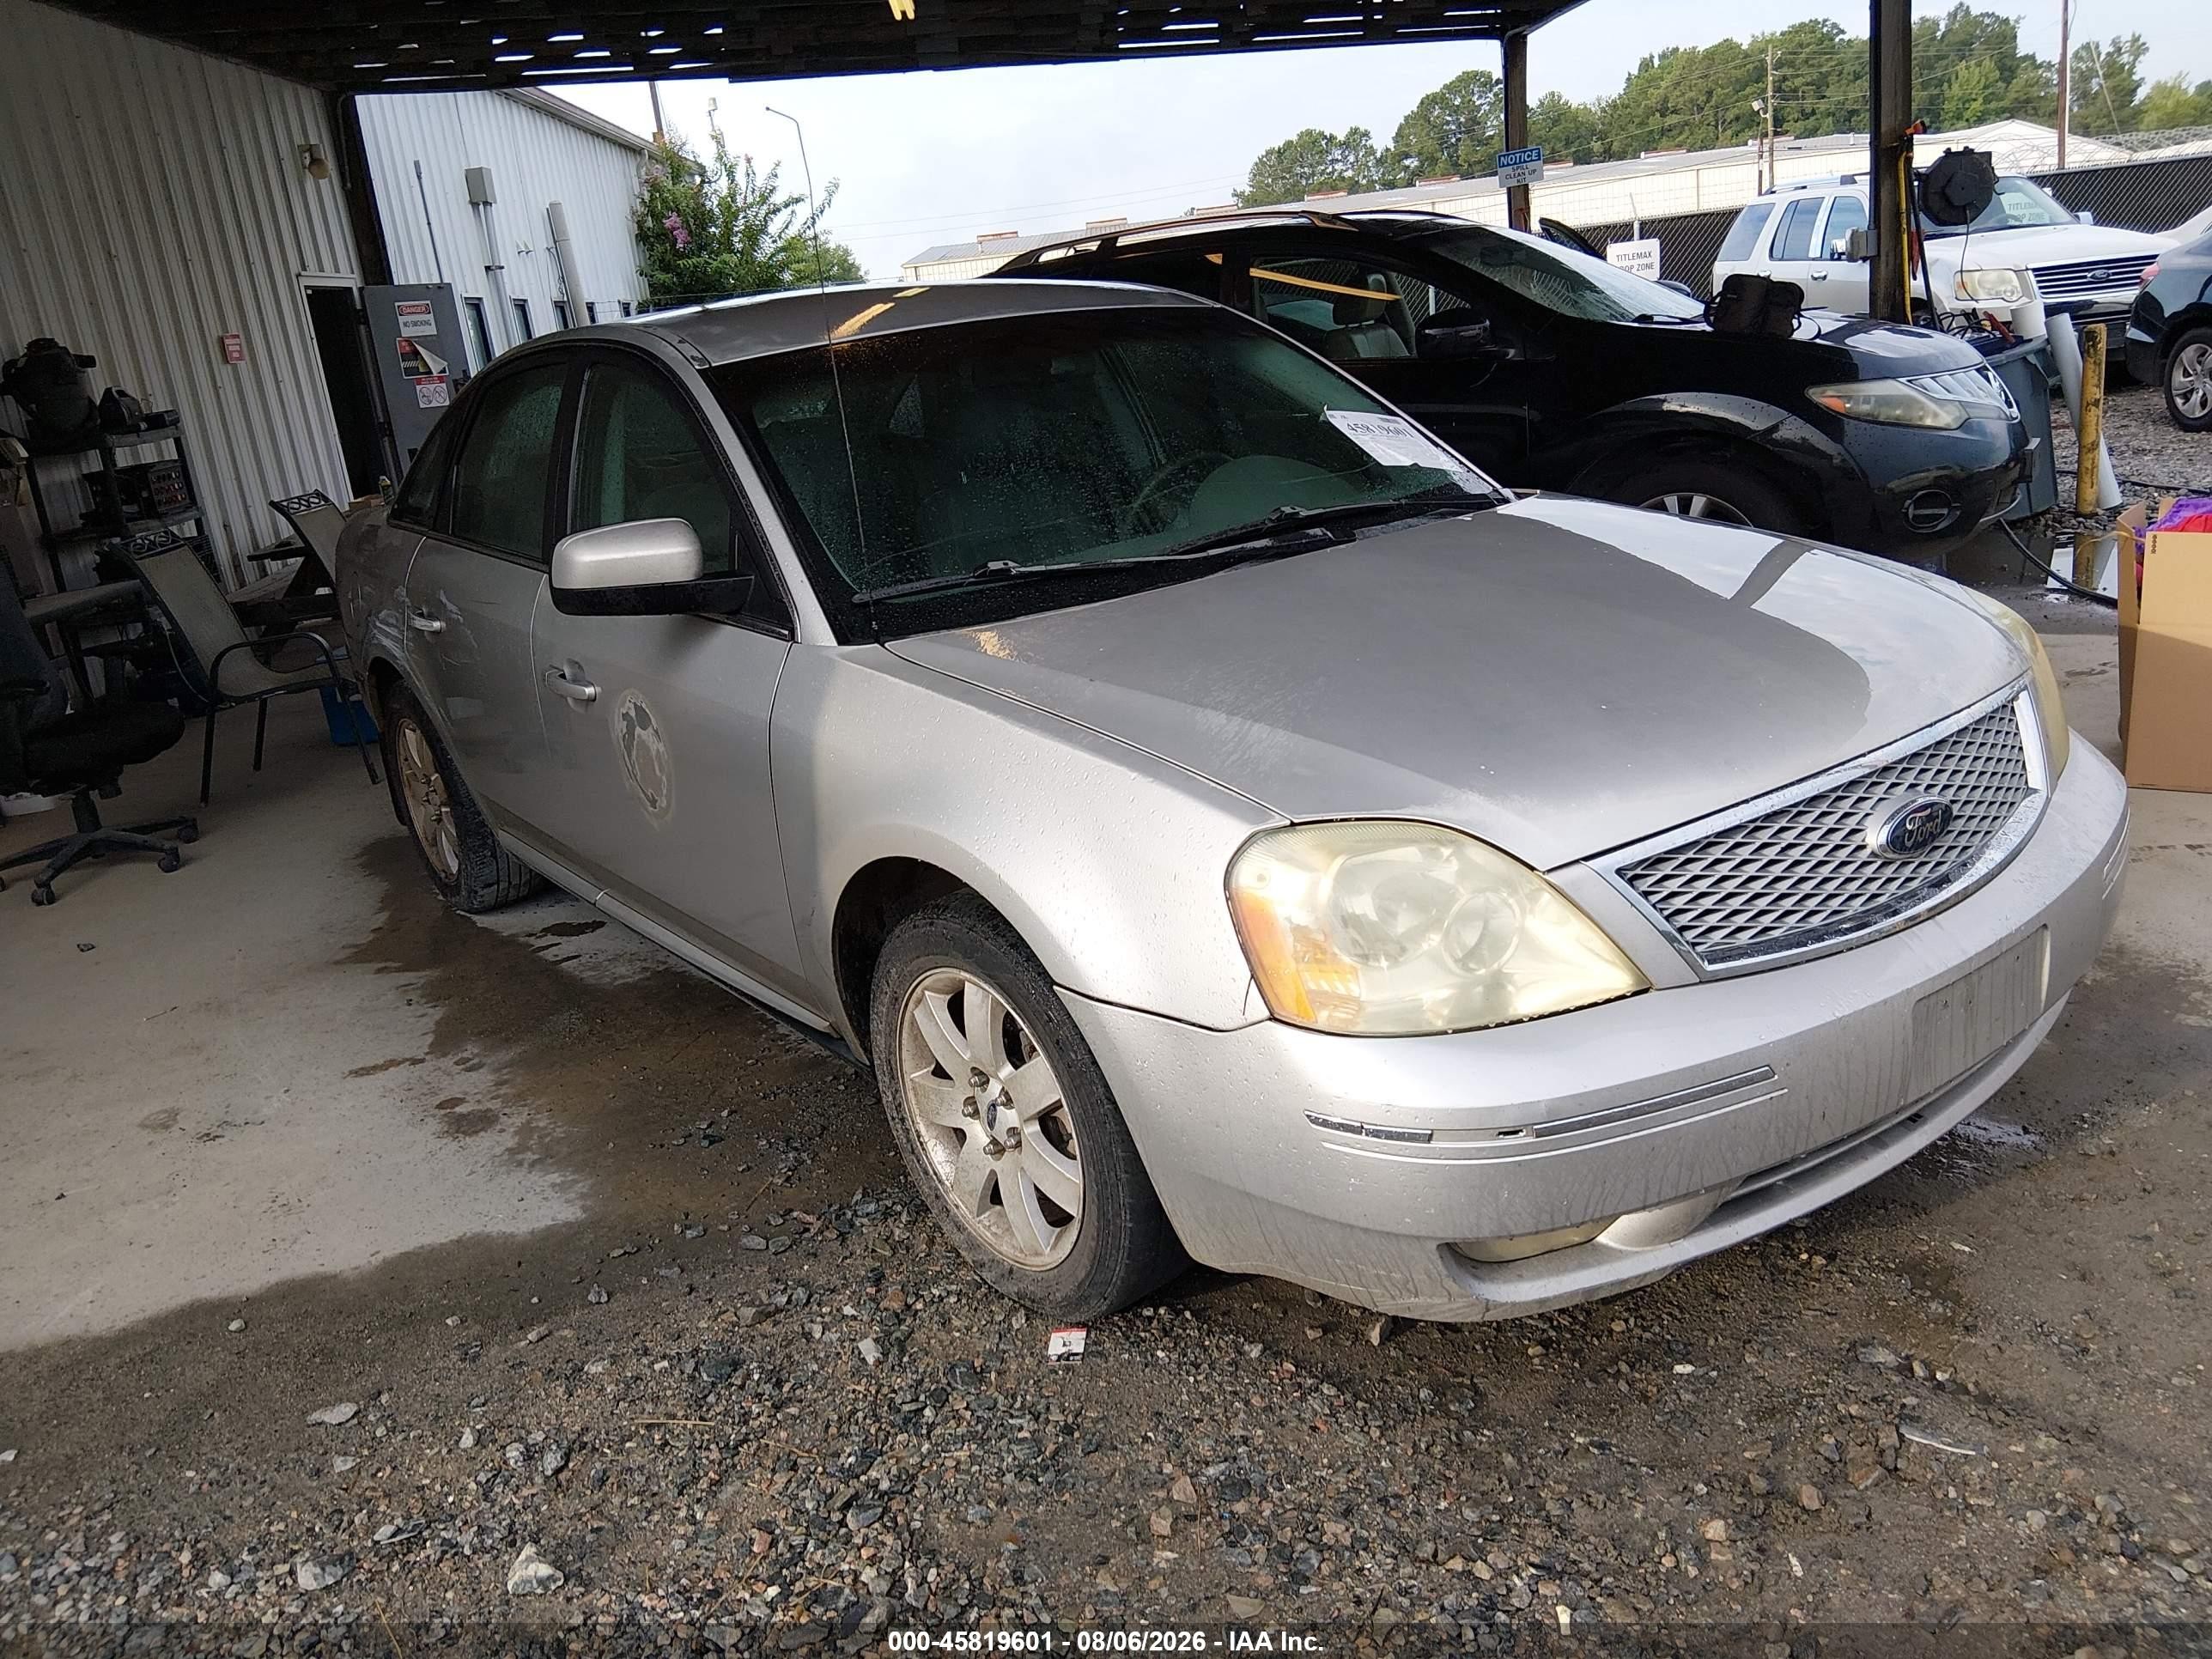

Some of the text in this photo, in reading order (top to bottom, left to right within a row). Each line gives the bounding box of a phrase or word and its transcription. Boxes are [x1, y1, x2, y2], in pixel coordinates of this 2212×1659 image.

[1499, 149, 1540, 167] NOTICE
[1511, 164, 1529, 173] SPILL
[1505, 171, 1526, 180] CLEAN
[1616, 250, 1652, 262] TITLEMAX
[1637, 262, 1656, 271] ZONE
[402, 306, 427, 314] DANGER
[1904, 807, 1943, 848] Ford
